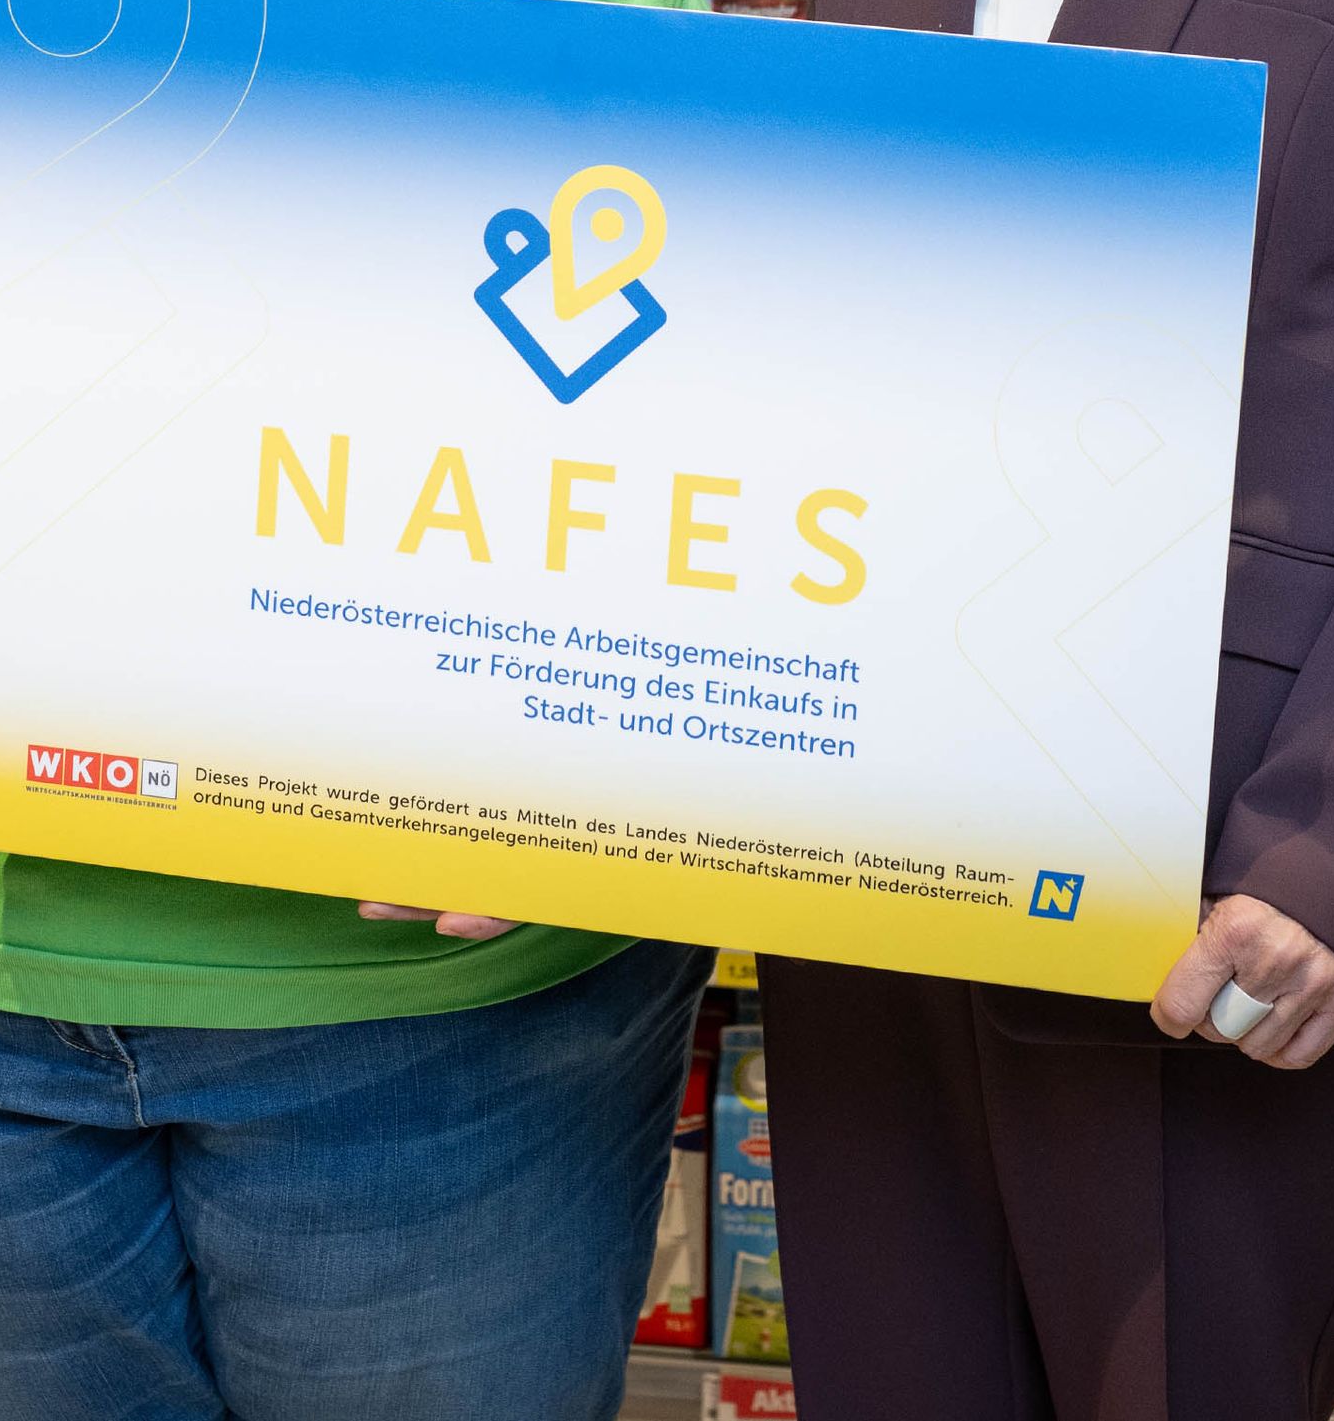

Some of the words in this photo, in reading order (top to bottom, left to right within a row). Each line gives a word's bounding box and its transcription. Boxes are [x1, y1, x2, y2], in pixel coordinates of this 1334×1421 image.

[255, 425, 871, 606] NAFES
[250, 588, 557, 647] Niederösterreichische
[564, 626, 860, 684] Arbeitsgemeinschaft
[435, 650, 481, 675] zur
[490, 654, 637, 701] Förderung
[645, 674, 696, 704] des
[704, 680, 825, 720] Einkaufs
[832, 696, 858, 721] in
[523, 694, 609, 727] Stadt-
[619, 709, 673, 737] und
[683, 715, 857, 759] Ortszentren
[25, 784, 106, 802] WIRTSCHAFTSKAMMER
[29, 748, 134, 790] WKO
[147, 769, 171, 788] NÖ
[193, 789, 266, 816] ordnung
[271, 798, 305, 817] und
[310, 803, 599, 857] Gesamtverkehrsangelegenheiten)
[604, 840, 640, 861] und
[643, 846, 672, 865] der
[679, 850, 853, 889] Wirtschaftskammer
[858, 873, 1015, 909] Niederösterreich.
[195, 766, 250, 789] Dieses
[258, 775, 318, 798] Projekt
[326, 785, 381, 804] wurde
[388, 790, 470, 817] gefördert
[478, 806, 508, 821] aus
[517, 808, 578, 831] Mitteln
[585, 818, 617, 836] des
[625, 822, 688, 845] Landes
[696, 830, 845, 865] Niederösterreich
[853, 850, 947, 881] (Abteilung
[955, 863, 1016, 886] Raum-
